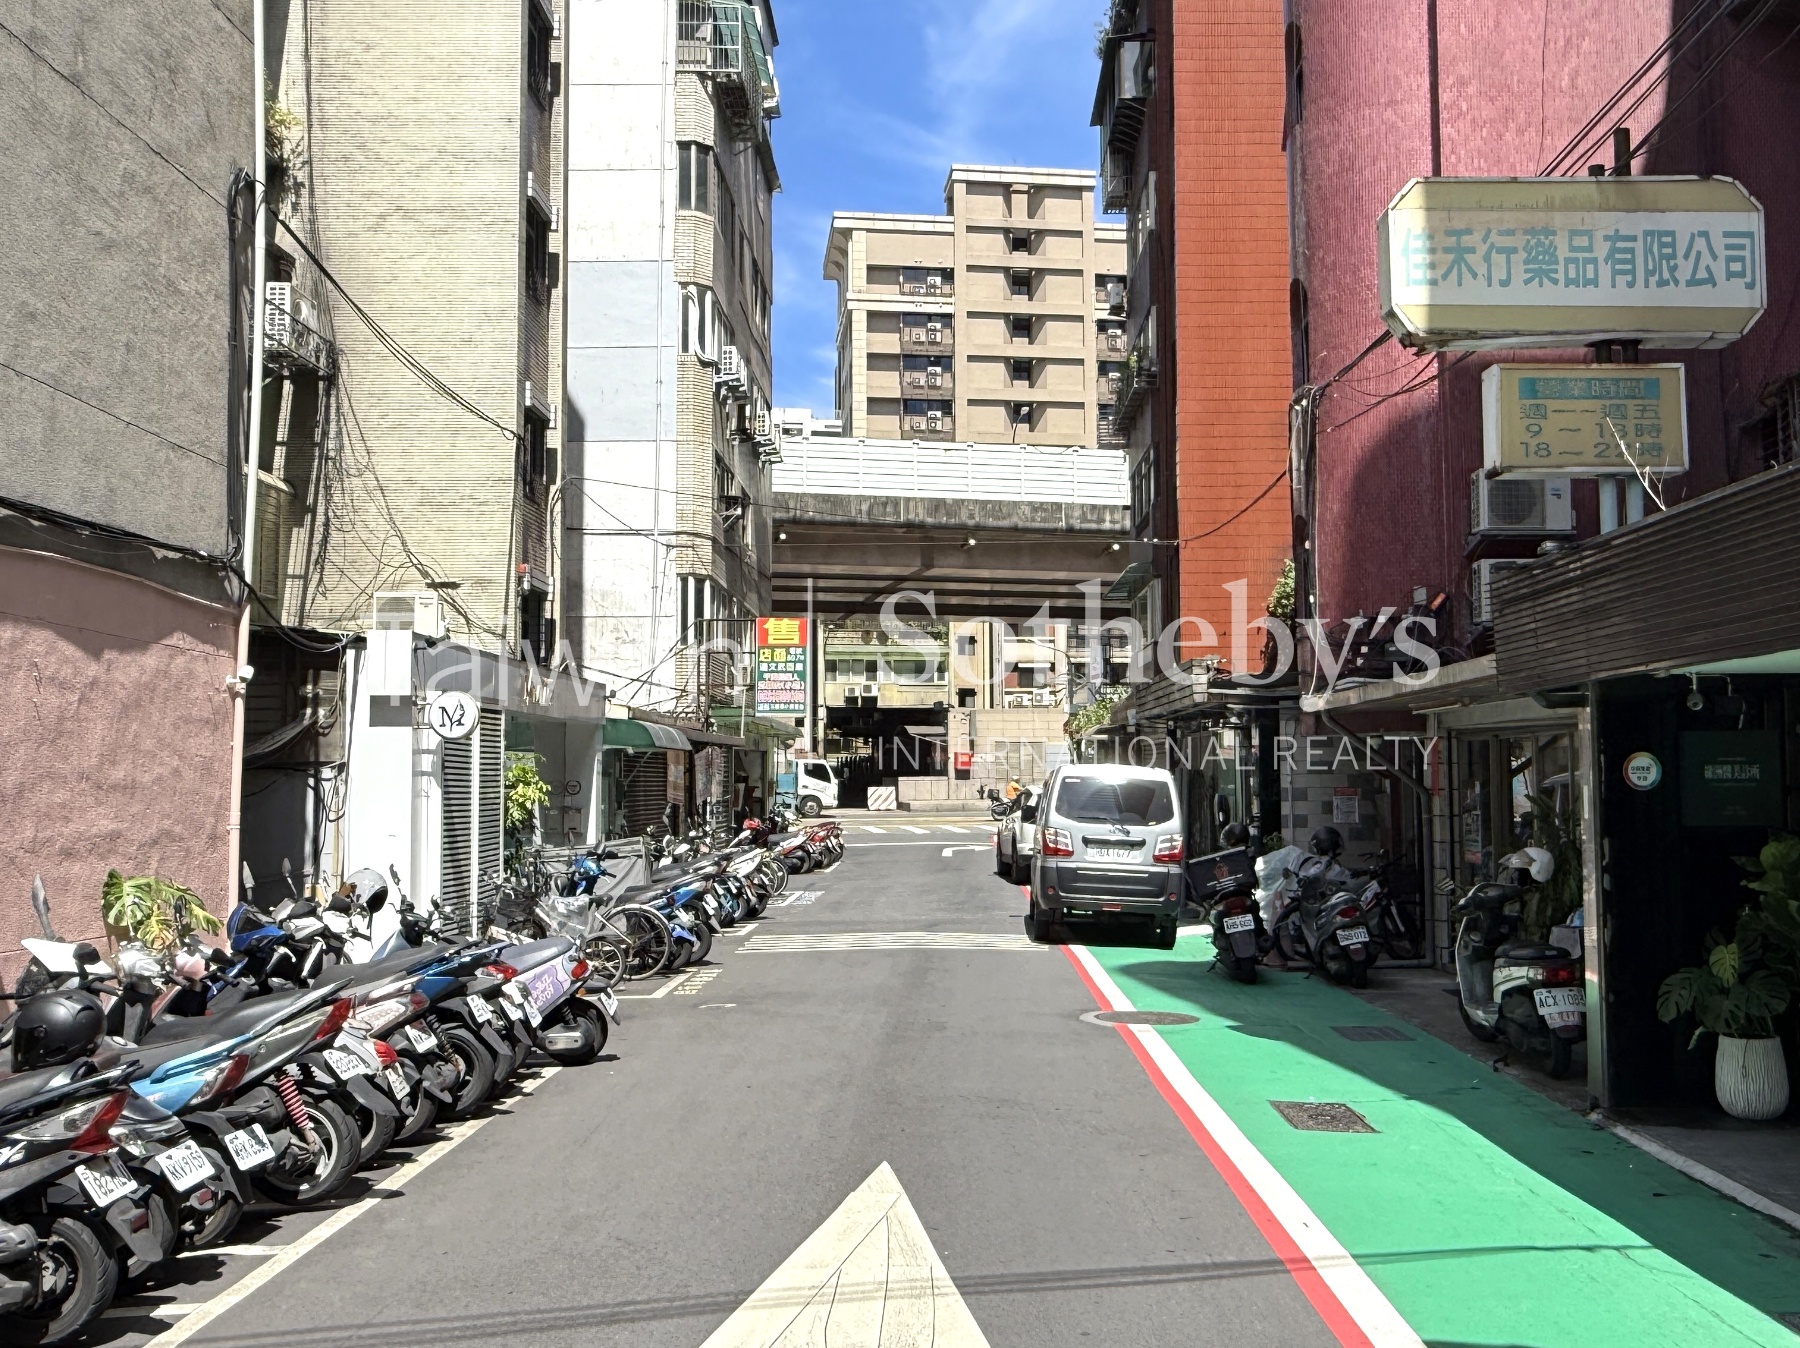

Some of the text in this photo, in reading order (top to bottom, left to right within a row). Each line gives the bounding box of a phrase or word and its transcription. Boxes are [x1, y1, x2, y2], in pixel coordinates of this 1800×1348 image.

[1402, 227, 1757, 290] 佳禾行藥品有限公司
[1535, 379, 1644, 397] 營業時間
[763, 618, 800, 644] 售
